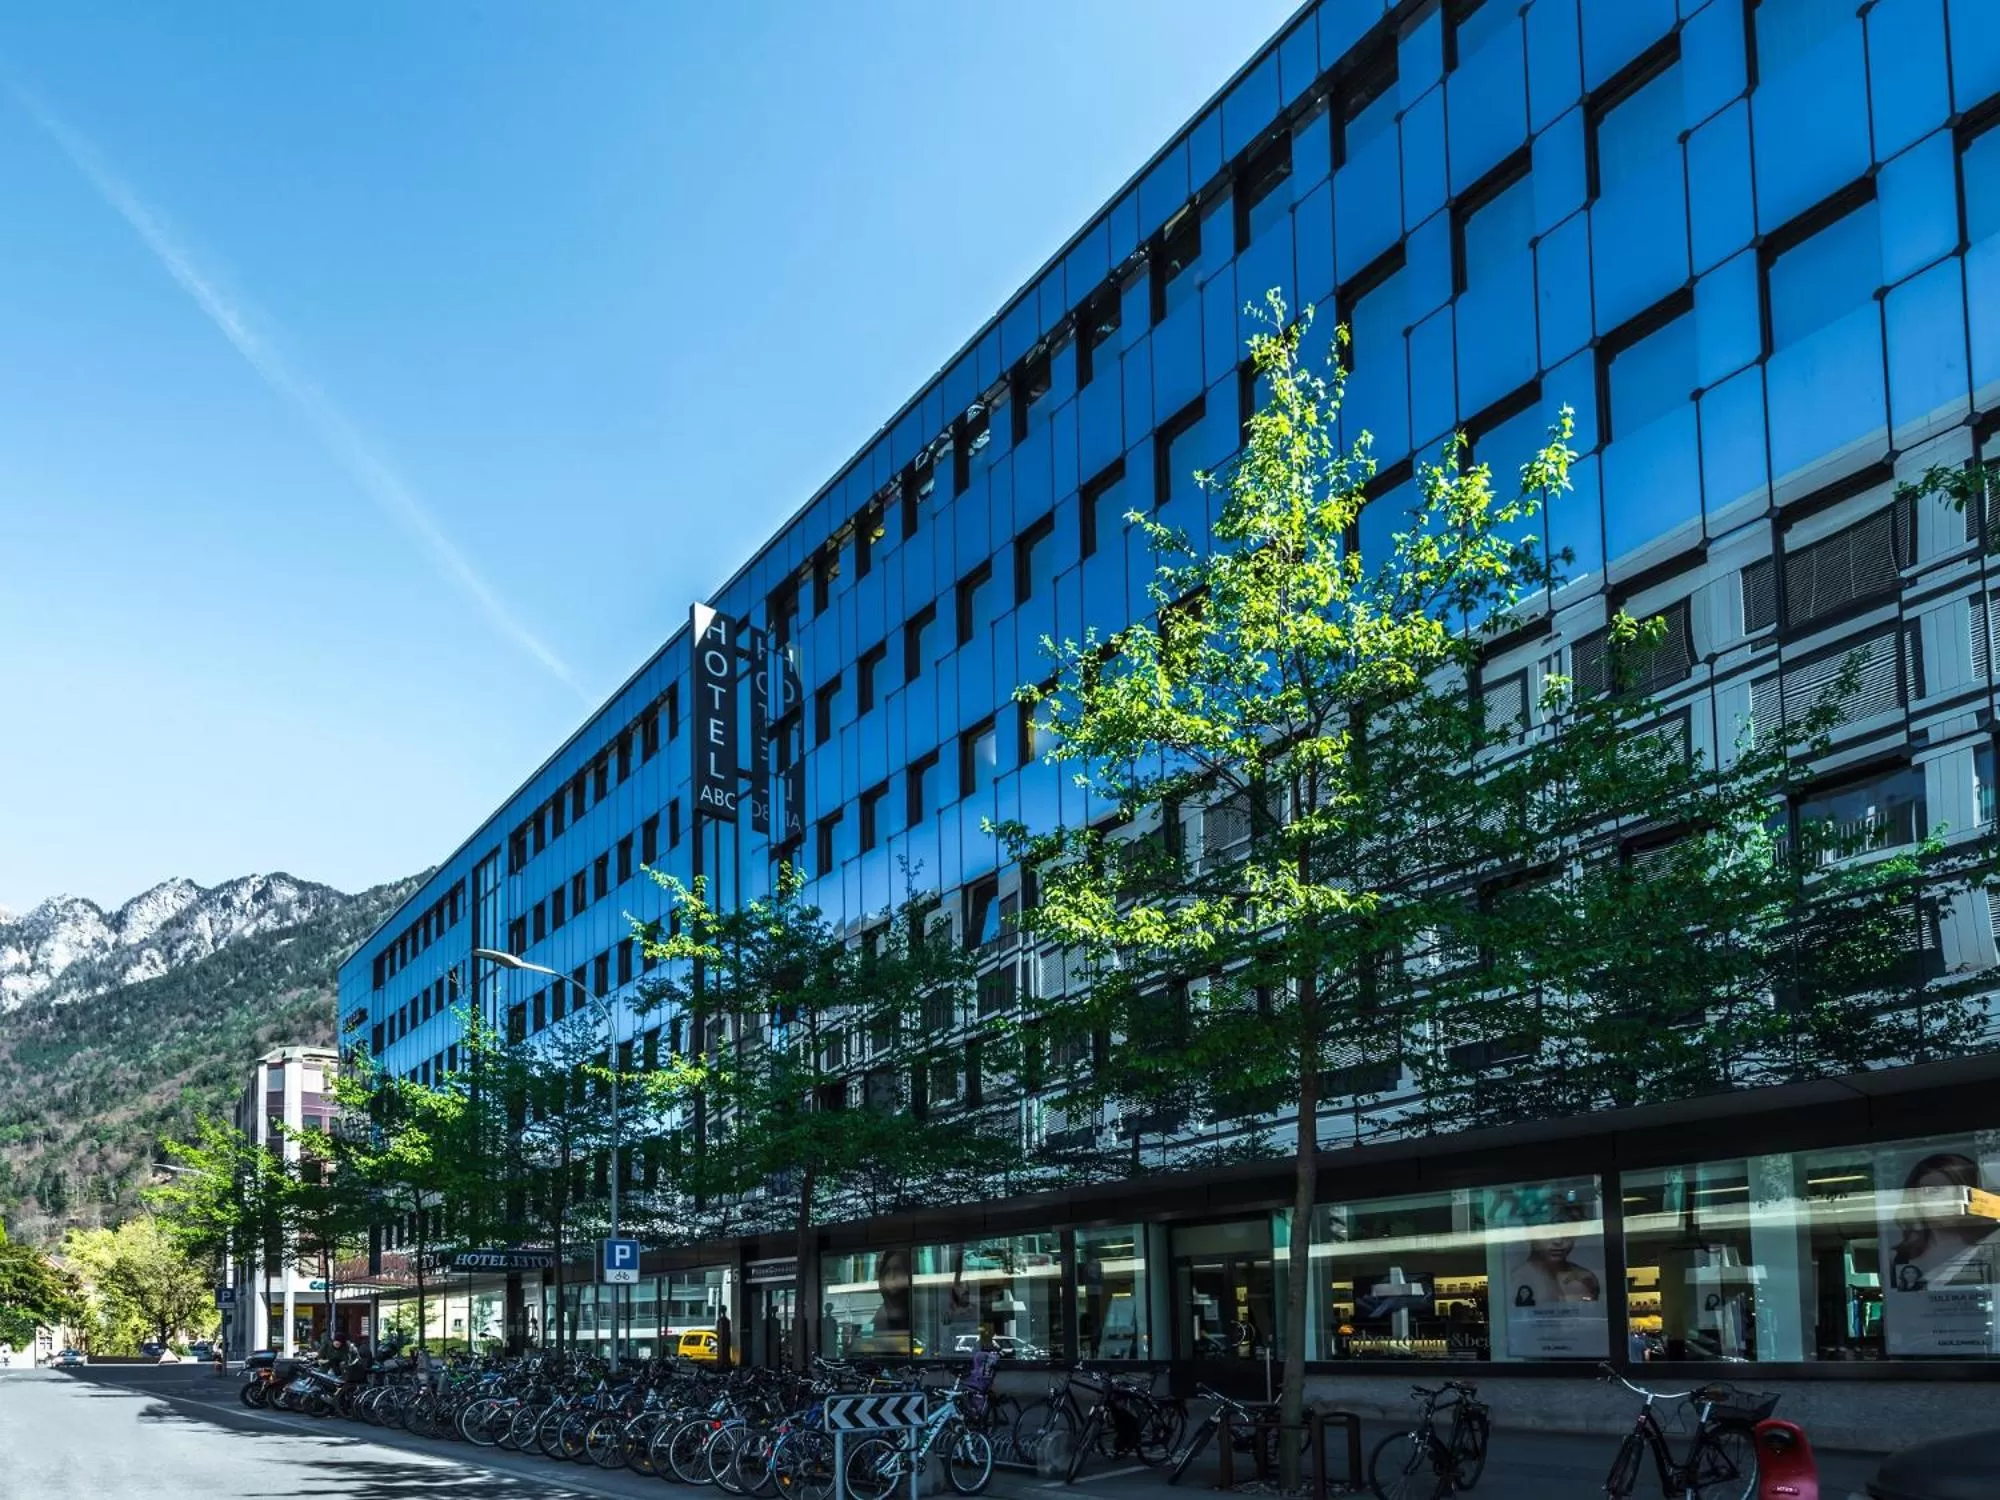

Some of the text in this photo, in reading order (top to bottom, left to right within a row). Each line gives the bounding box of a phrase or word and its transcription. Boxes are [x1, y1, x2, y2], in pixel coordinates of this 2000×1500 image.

[704, 620, 728, 780] HOTEL
[700, 784, 736, 811] ABC
[454, 1253, 508, 1267] HOTEL
[615, 1245, 630, 1267] P
